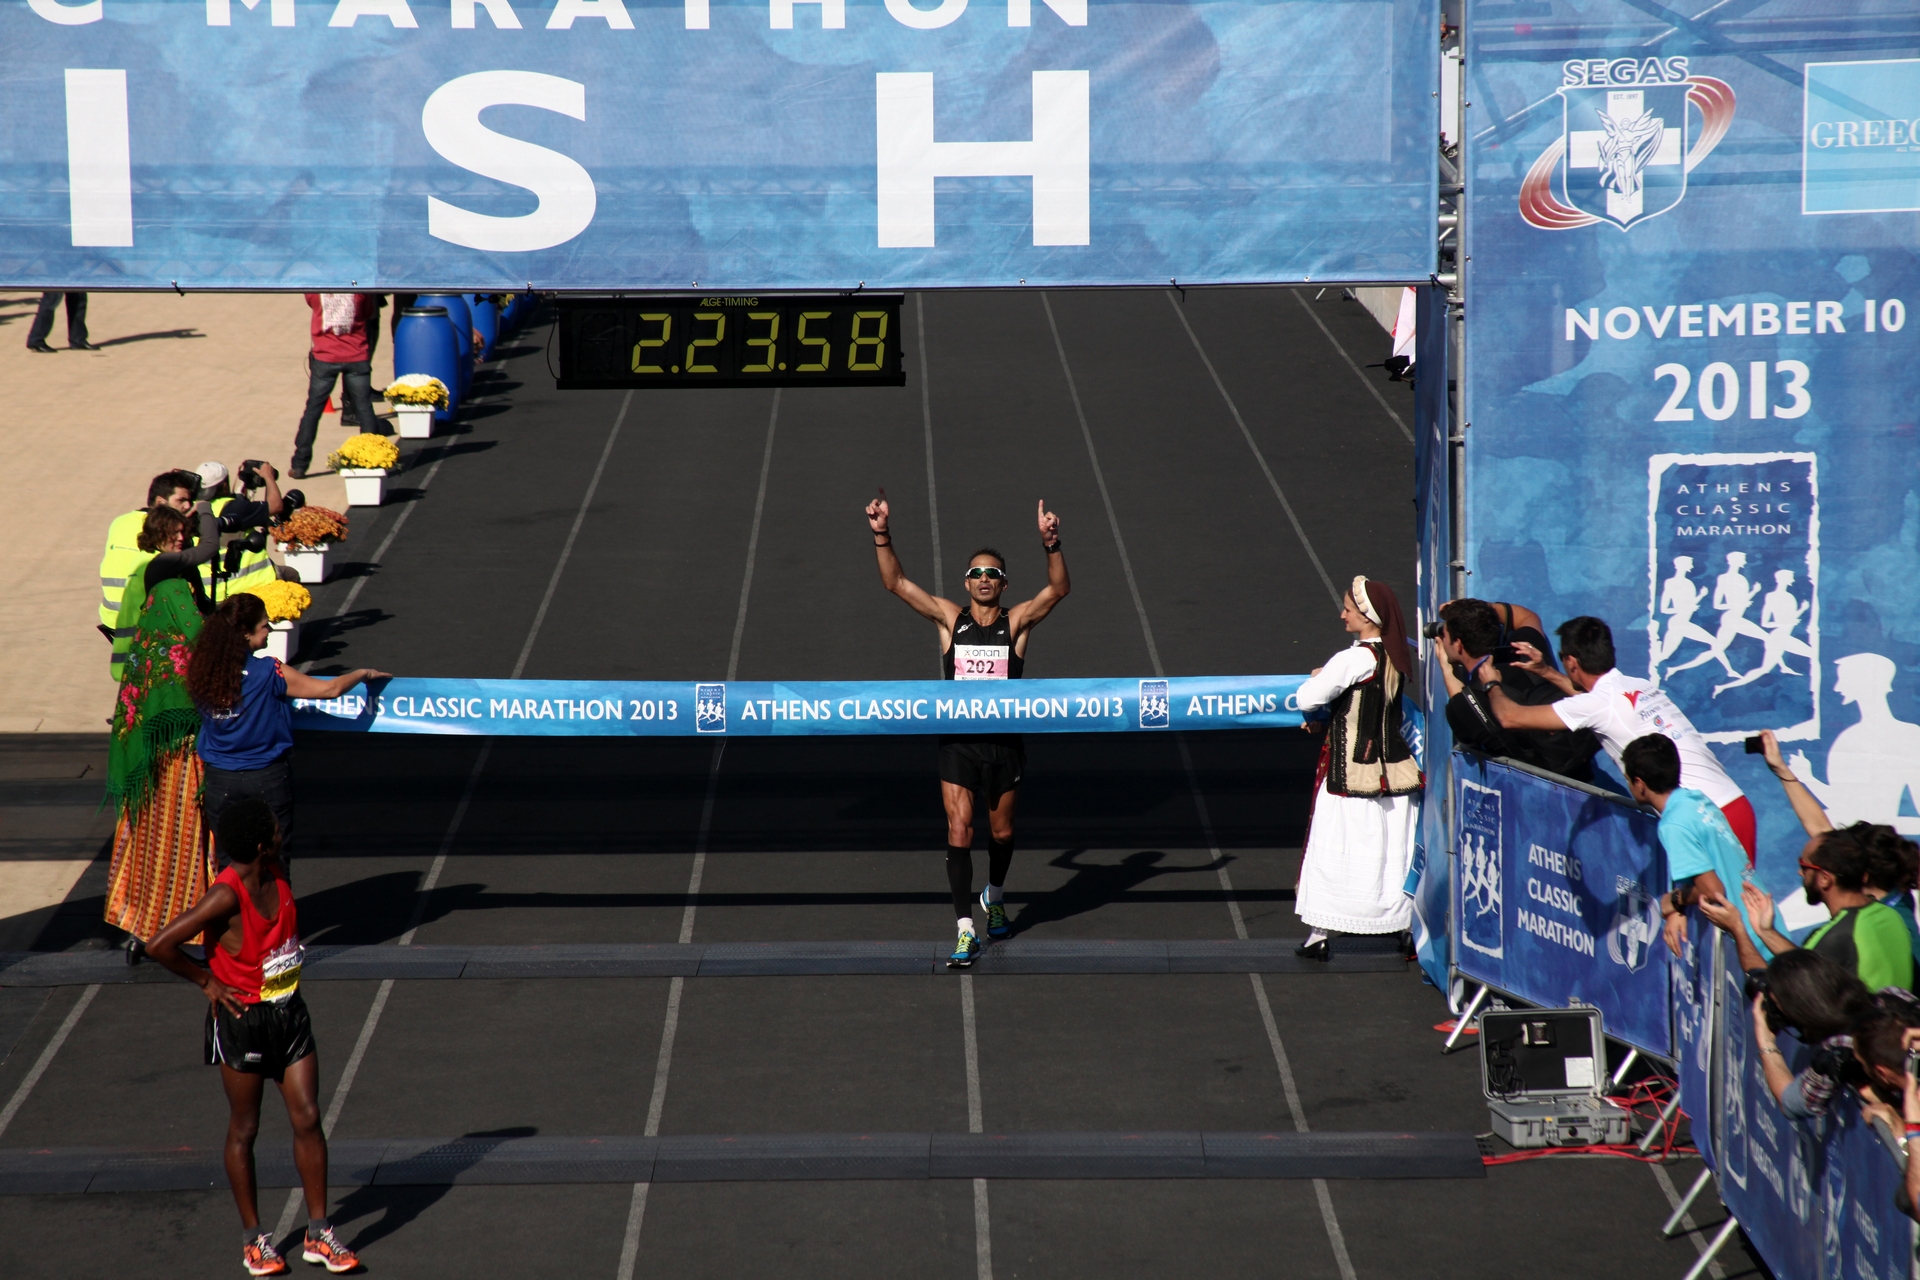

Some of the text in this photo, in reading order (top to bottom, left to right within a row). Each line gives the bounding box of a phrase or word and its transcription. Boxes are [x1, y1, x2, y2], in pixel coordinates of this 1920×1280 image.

[1562, 56, 1689, 86] SEGAS
[1564, 299, 1906, 341] NOVEMBER 10
[1653, 360, 1812, 422] 2013
[1676, 481, 1791, 495] ATHENS
[1676, 502, 1791, 516] CLASSIC
[1676, 524, 1791, 537] MARATHON
[966, 659, 995, 674] 202
[294, 695, 678, 721] ATHENS CLASSIC MARATHON 2013
[741, 697, 1123, 720] ATHENS CLASSIC MARATHON 2013
[1186, 693, 1277, 716] ATHENS
[1528, 843, 1582, 881] ATHENS
[1527, 877, 1583, 917] CLASSIC
[1517, 907, 1595, 957] MARATHON
